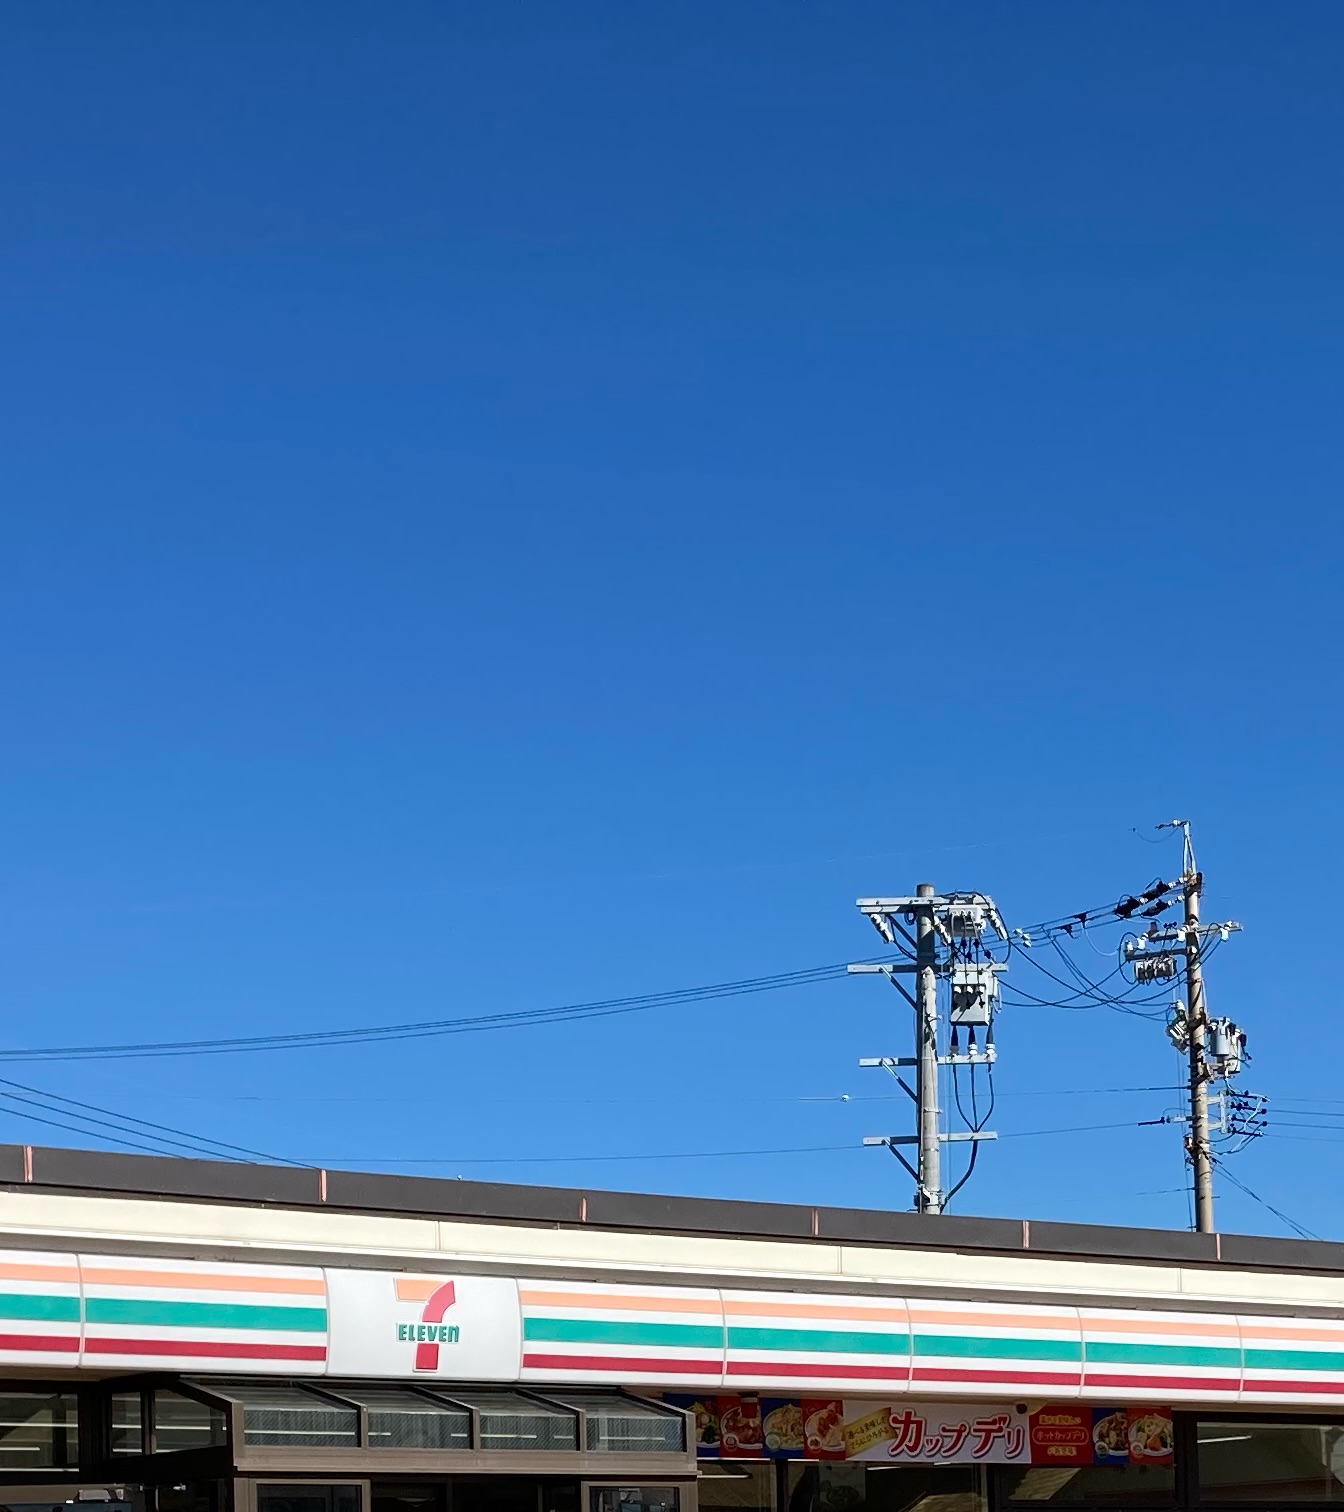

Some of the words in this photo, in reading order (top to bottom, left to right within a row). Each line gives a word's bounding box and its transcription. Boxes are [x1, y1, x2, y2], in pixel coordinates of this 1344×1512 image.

[394, 1278, 456, 1371] 7
[888, 1409, 1024, 1459] カップデリ
